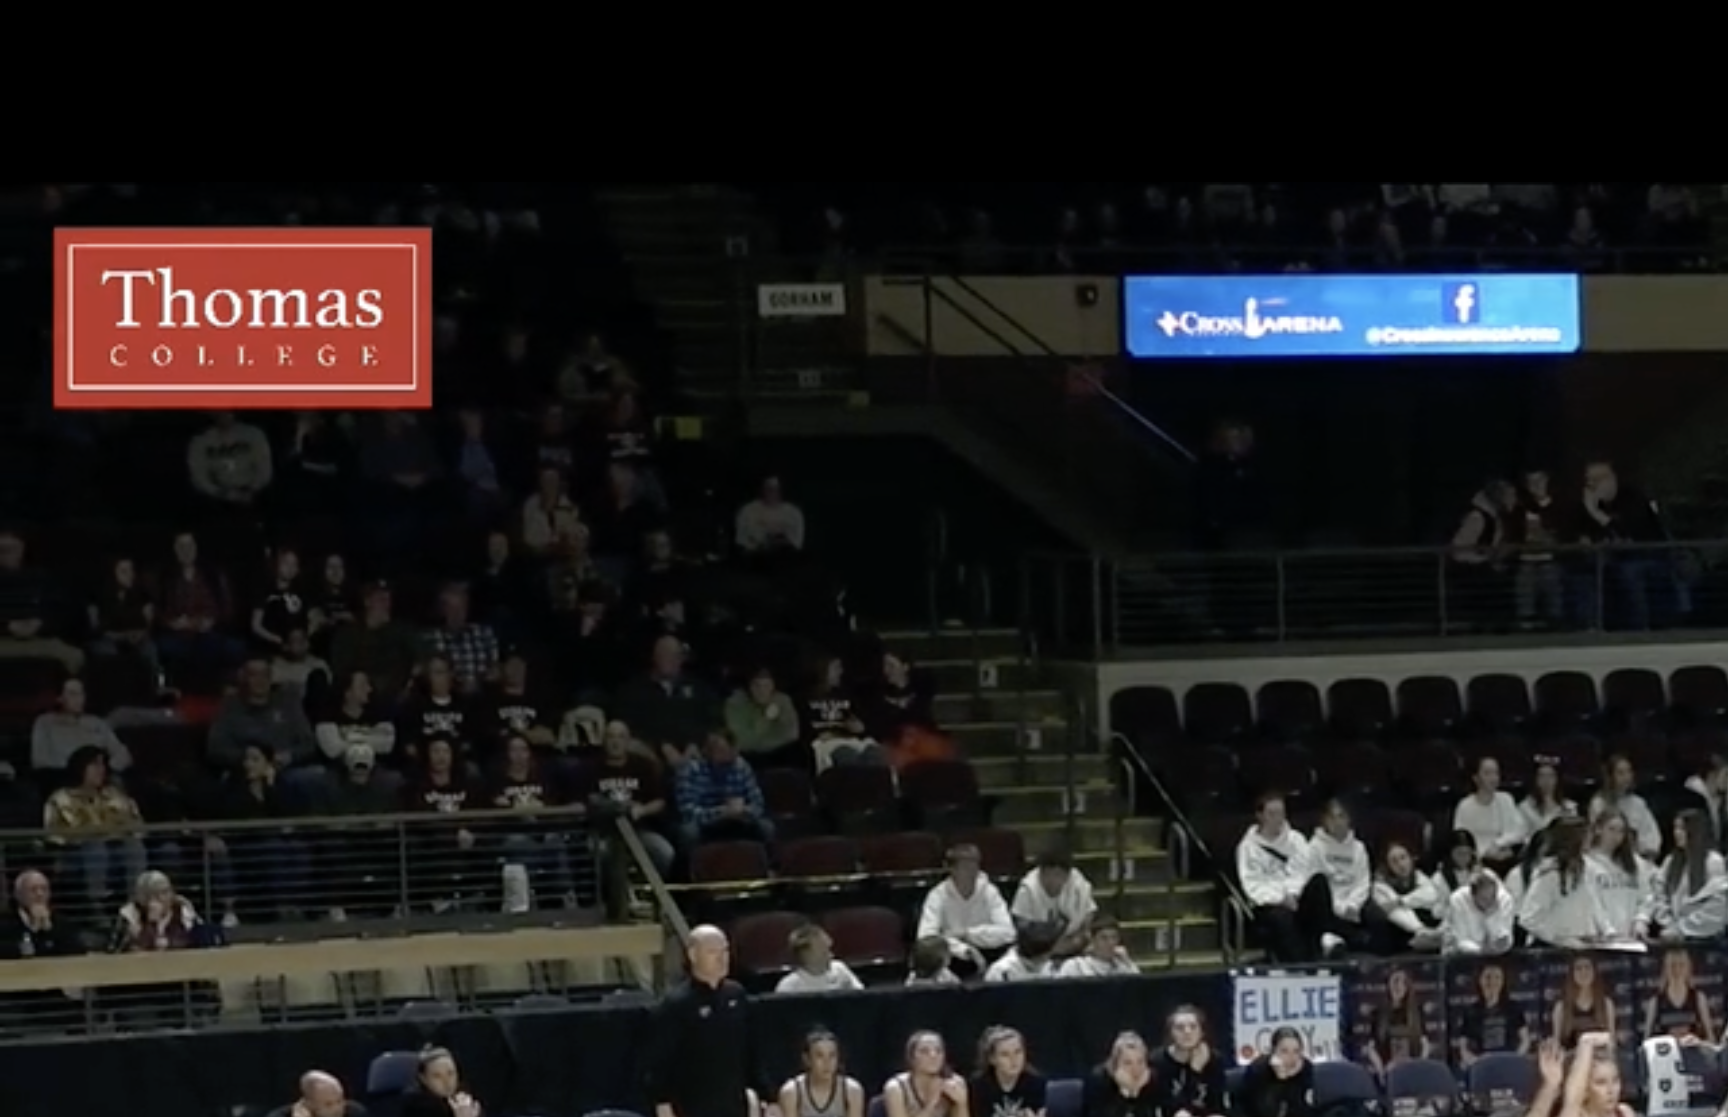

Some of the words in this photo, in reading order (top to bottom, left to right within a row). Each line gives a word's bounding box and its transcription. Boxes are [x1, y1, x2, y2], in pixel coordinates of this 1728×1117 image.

[768, 290, 832, 309] GORHAM
[1263, 315, 1344, 333] ARENA
[1240, 986, 1337, 1024] ELLIE
